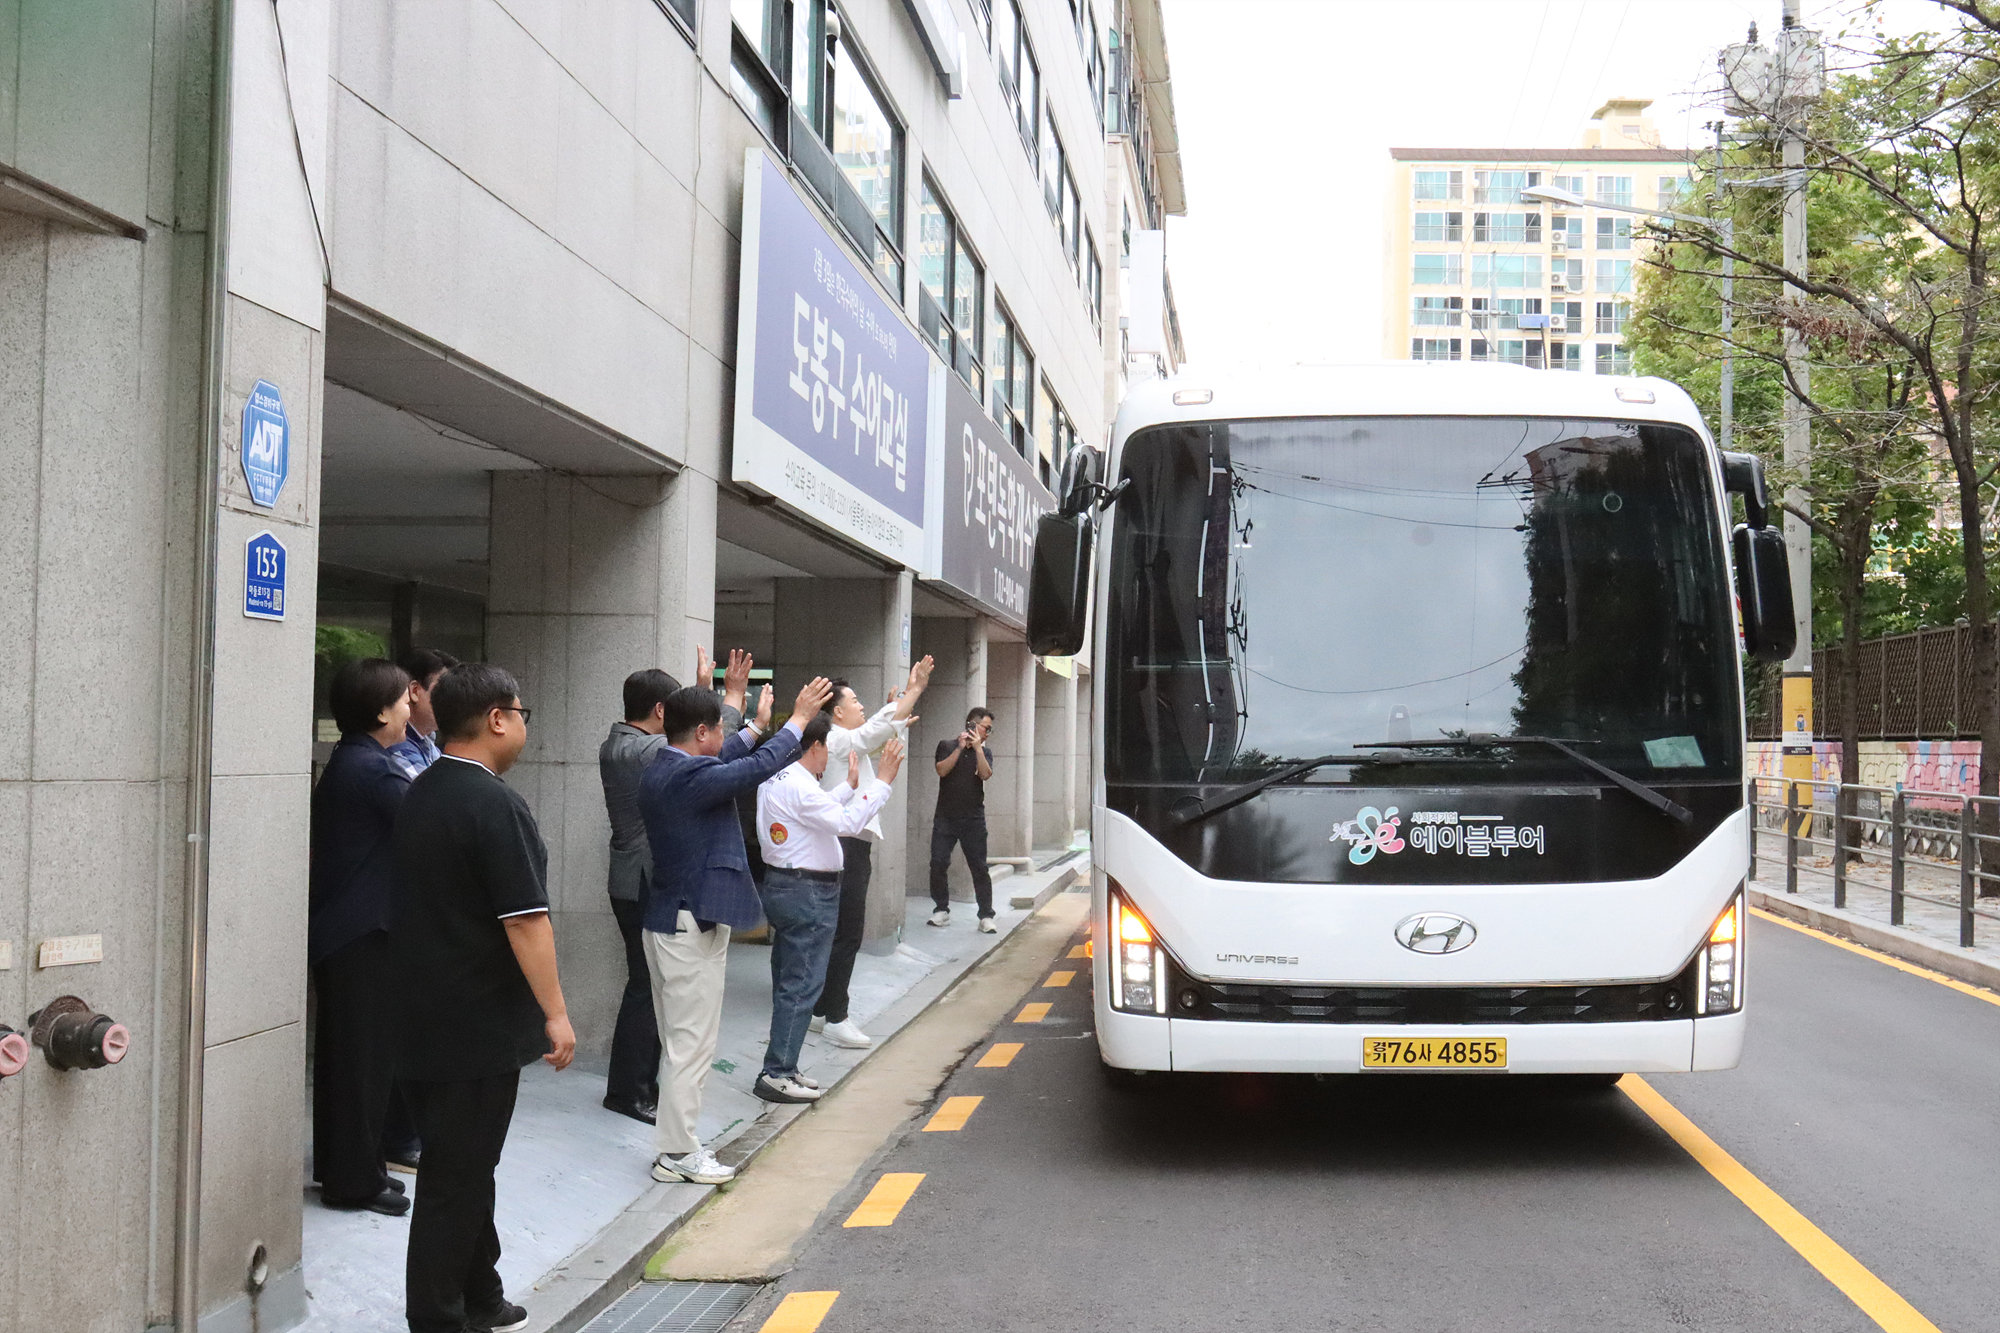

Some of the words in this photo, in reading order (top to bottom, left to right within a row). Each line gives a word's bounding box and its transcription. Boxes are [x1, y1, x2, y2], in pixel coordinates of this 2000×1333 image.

[789, 292, 846, 440] 도봉구
[850, 353, 909, 493] 수어교실
[250, 419, 283, 467] ADT
[255, 546, 278, 579] 153
[1411, 811, 1458, 824] 사회적기업
[1410, 825, 1545, 857] 에이블투어
[1216, 953, 1299, 965] UNIVERSE
[1437, 1042, 1498, 1064] 4855
